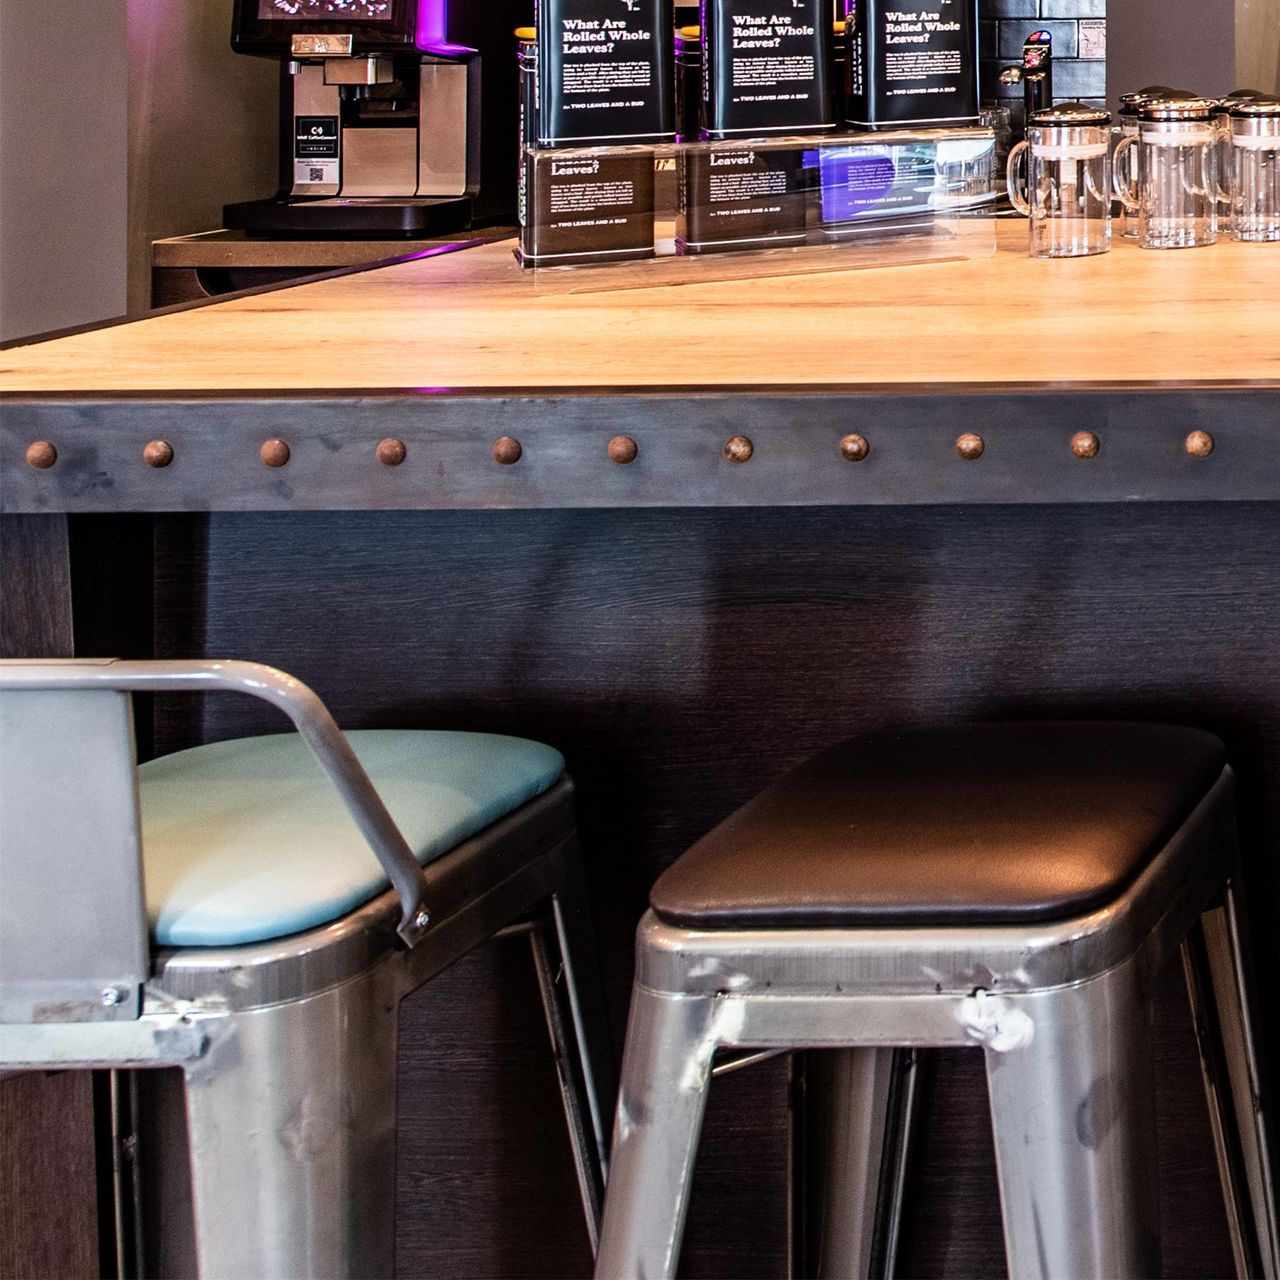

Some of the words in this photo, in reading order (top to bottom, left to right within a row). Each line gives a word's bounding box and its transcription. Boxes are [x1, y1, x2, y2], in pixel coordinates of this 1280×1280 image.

[732, 15, 767, 25] What
[769, 15, 792, 24] Are
[885, 12, 917, 21] What
[919, 11, 940, 20] Are
[563, 20, 600, 30] What
[602, 19, 626, 29] Are
[885, 23, 922, 33] Rolled
[924, 22, 960, 31] Whole
[563, 31, 606, 42] Rolled
[608, 30, 651, 40] Whole
[733, 27, 773, 37] Rolled
[774, 26, 814, 36] Whole
[732, 38, 781, 48] Leaves?
[886, 33, 930, 44] Leaves?
[563, 43, 615, 53] Leaves?
[551, 163, 599, 176] Leaves?
